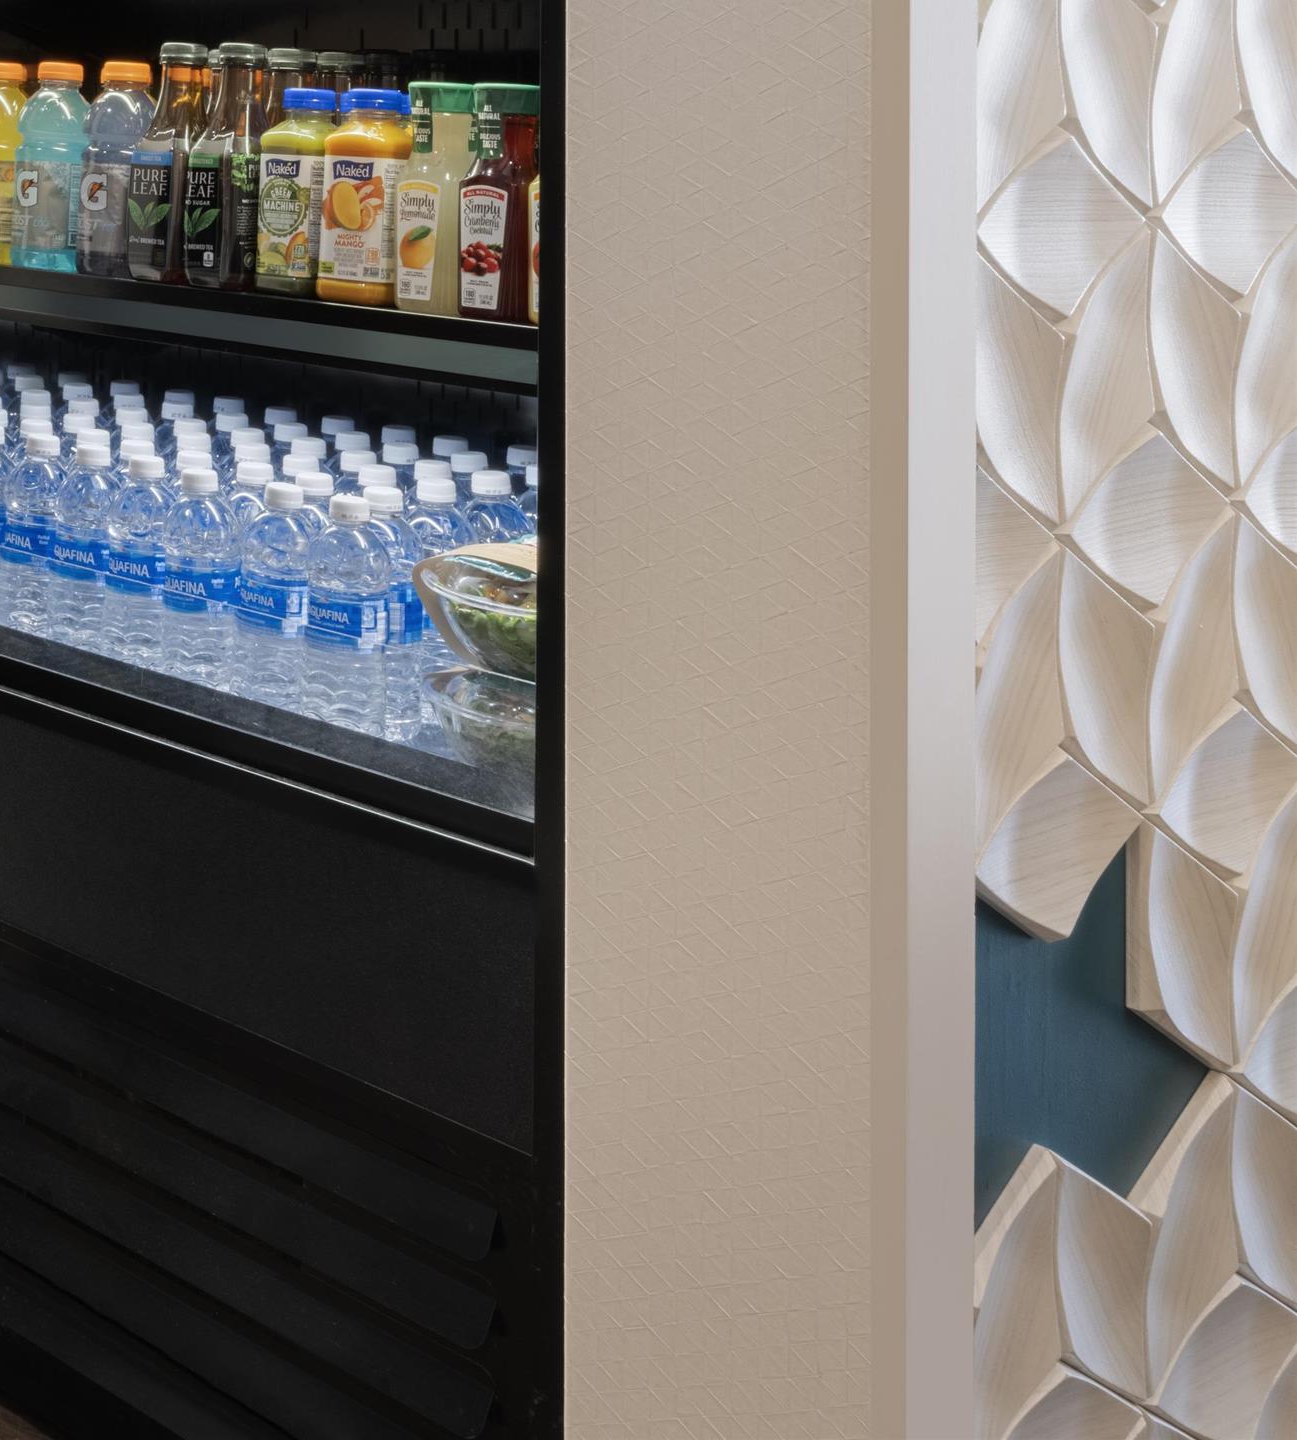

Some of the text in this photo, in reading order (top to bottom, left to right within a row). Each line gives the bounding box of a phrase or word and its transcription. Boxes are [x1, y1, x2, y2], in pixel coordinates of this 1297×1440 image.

[133, 168, 168, 182] PURE
[16, 165, 39, 207] G
[80, 171, 108, 211] G
[132, 181, 167, 196] LEAF
[271, 187, 293, 200] GREEN
[264, 200, 301, 212] MACHINE
[400, 191, 436, 212] Simply
[400, 207, 436, 221] Lemonade
[463, 199, 501, 220] Simply
[464, 215, 500, 231] Cranberry
[334, 240, 364, 248] MANGO
